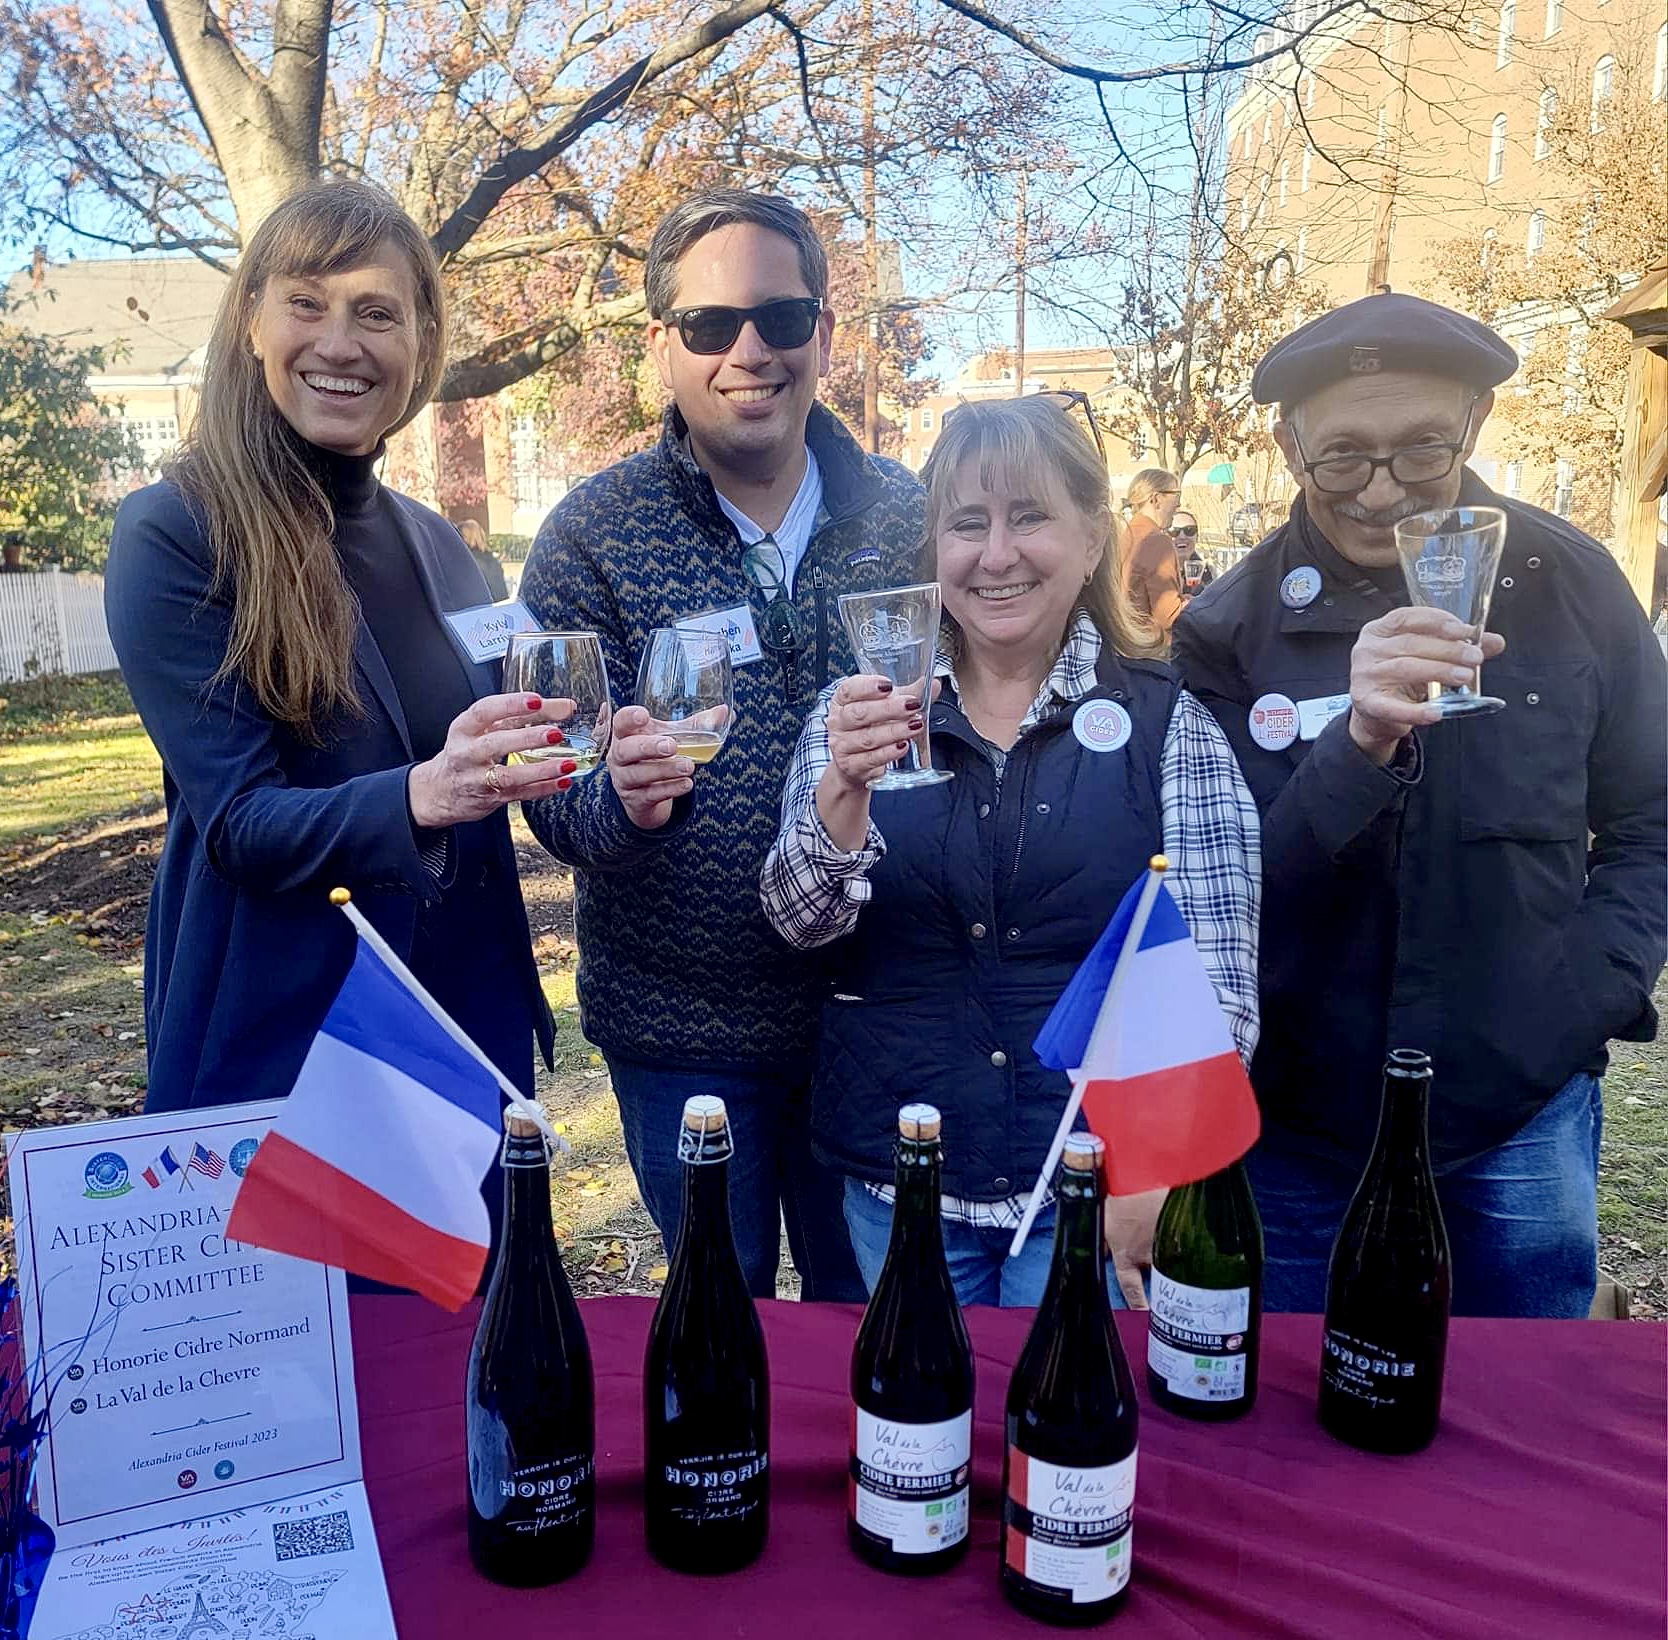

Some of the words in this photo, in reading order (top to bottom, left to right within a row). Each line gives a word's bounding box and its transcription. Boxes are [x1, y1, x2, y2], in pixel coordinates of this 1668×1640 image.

[1091, 714, 1115, 730] VA
[1267, 716, 1294, 729] CIDER
[1267, 730, 1296, 739] FESTIVAL
[101, 1244, 186, 1275] SISTER
[200, 1234, 258, 1258] CIT
[107, 1263, 264, 1308] COMMITTEE
[1158, 1279, 1176, 1301] Val
[92, 1348, 169, 1375] Honorie
[174, 1336, 223, 1358] Cidre
[228, 1316, 310, 1348] Normand
[1171, 1324, 1222, 1345] FERMIER
[96, 1393, 118, 1409] La
[121, 1383, 147, 1403] Val
[152, 1379, 174, 1398] de
[179, 1375, 194, 1393] la
[199, 1366, 261, 1388] Chevre
[875, 1424, 899, 1446] Val
[128, 1452, 182, 1471] Alexandria
[185, 1444, 211, 1458] Cider
[214, 1435, 249, 1452] Festival
[251, 1428, 278, 1444] 2023
[499, 1456, 595, 1498] HONORI
[665, 1451, 768, 1487] HONORIE
[860, 1463, 895, 1486] CIDRE
[896, 1472, 952, 1489] FERMIER
[1055, 1472, 1083, 1493] Val
[544, 1493, 569, 1505] CIDRE
[1032, 1515, 1076, 1534] CIDRE
[1078, 1510, 1128, 1535] FERMIER
